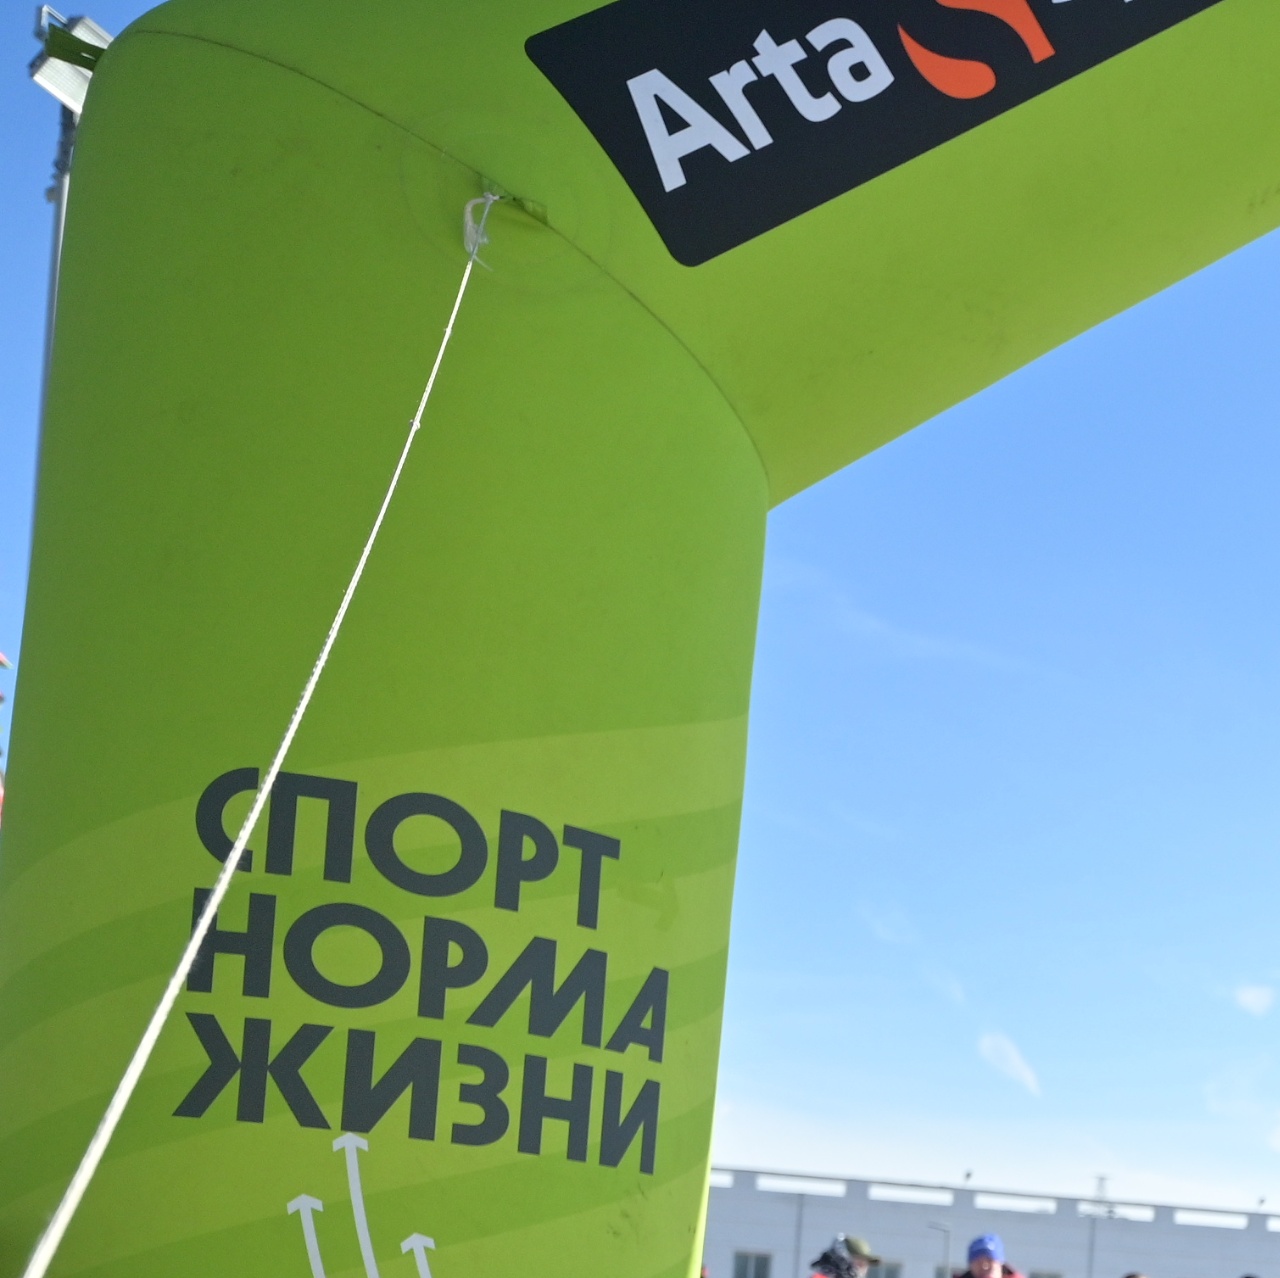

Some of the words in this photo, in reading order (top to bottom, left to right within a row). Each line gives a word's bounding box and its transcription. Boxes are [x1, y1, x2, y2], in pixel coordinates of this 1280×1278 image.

[626, 17, 895, 192] Arta
[195, 767, 621, 930] СПОРТ
[186, 887, 669, 1064] НОРМА
[171, 1012, 661, 1176] ЖИЗНИ
